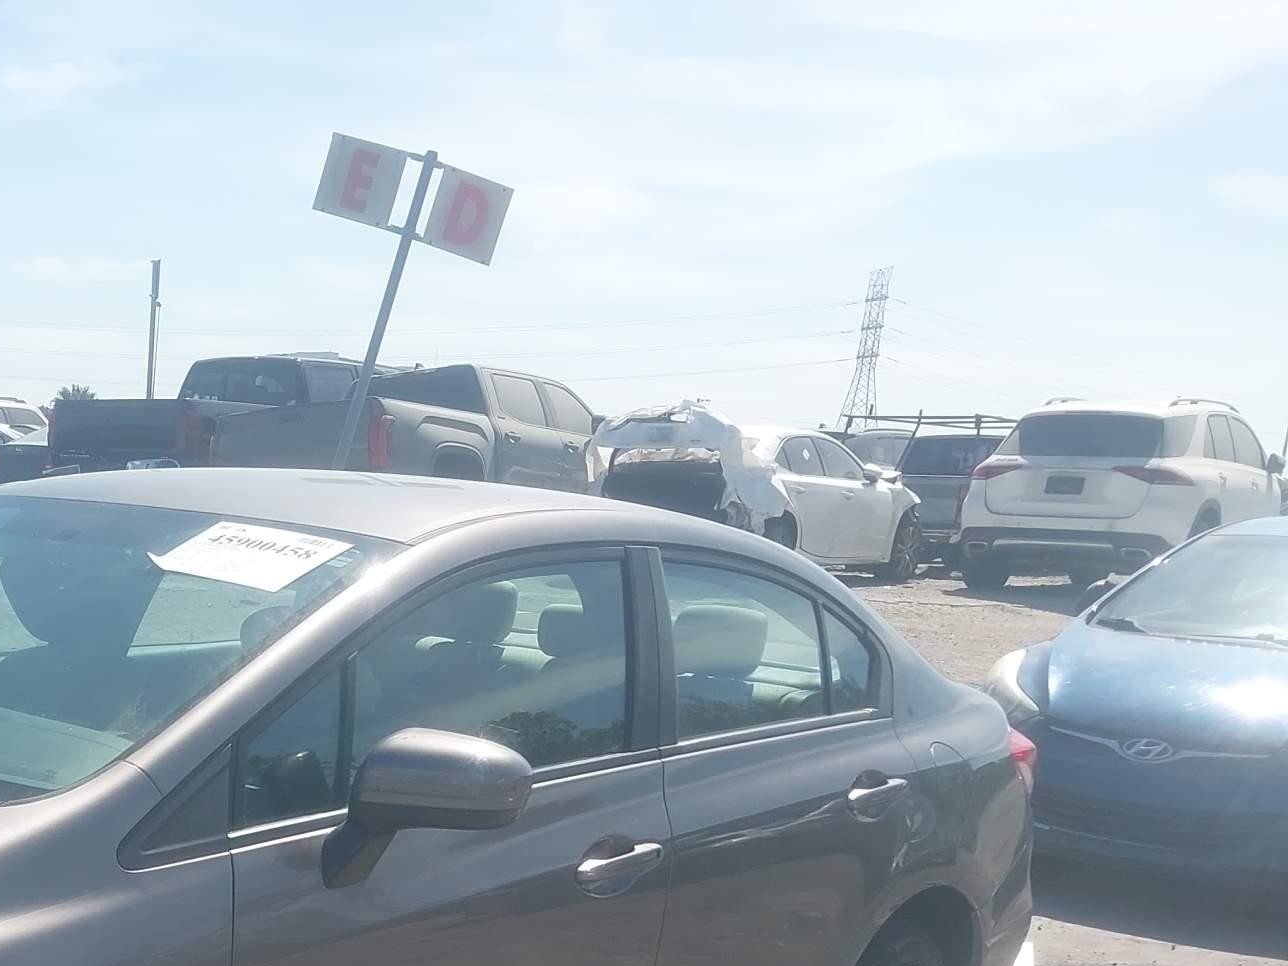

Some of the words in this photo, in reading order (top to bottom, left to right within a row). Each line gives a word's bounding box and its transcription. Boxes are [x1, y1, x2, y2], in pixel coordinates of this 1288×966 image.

[339, 148, 381, 214] E
[443, 180, 489, 246] D
[208, 533, 318, 560] 45900458
